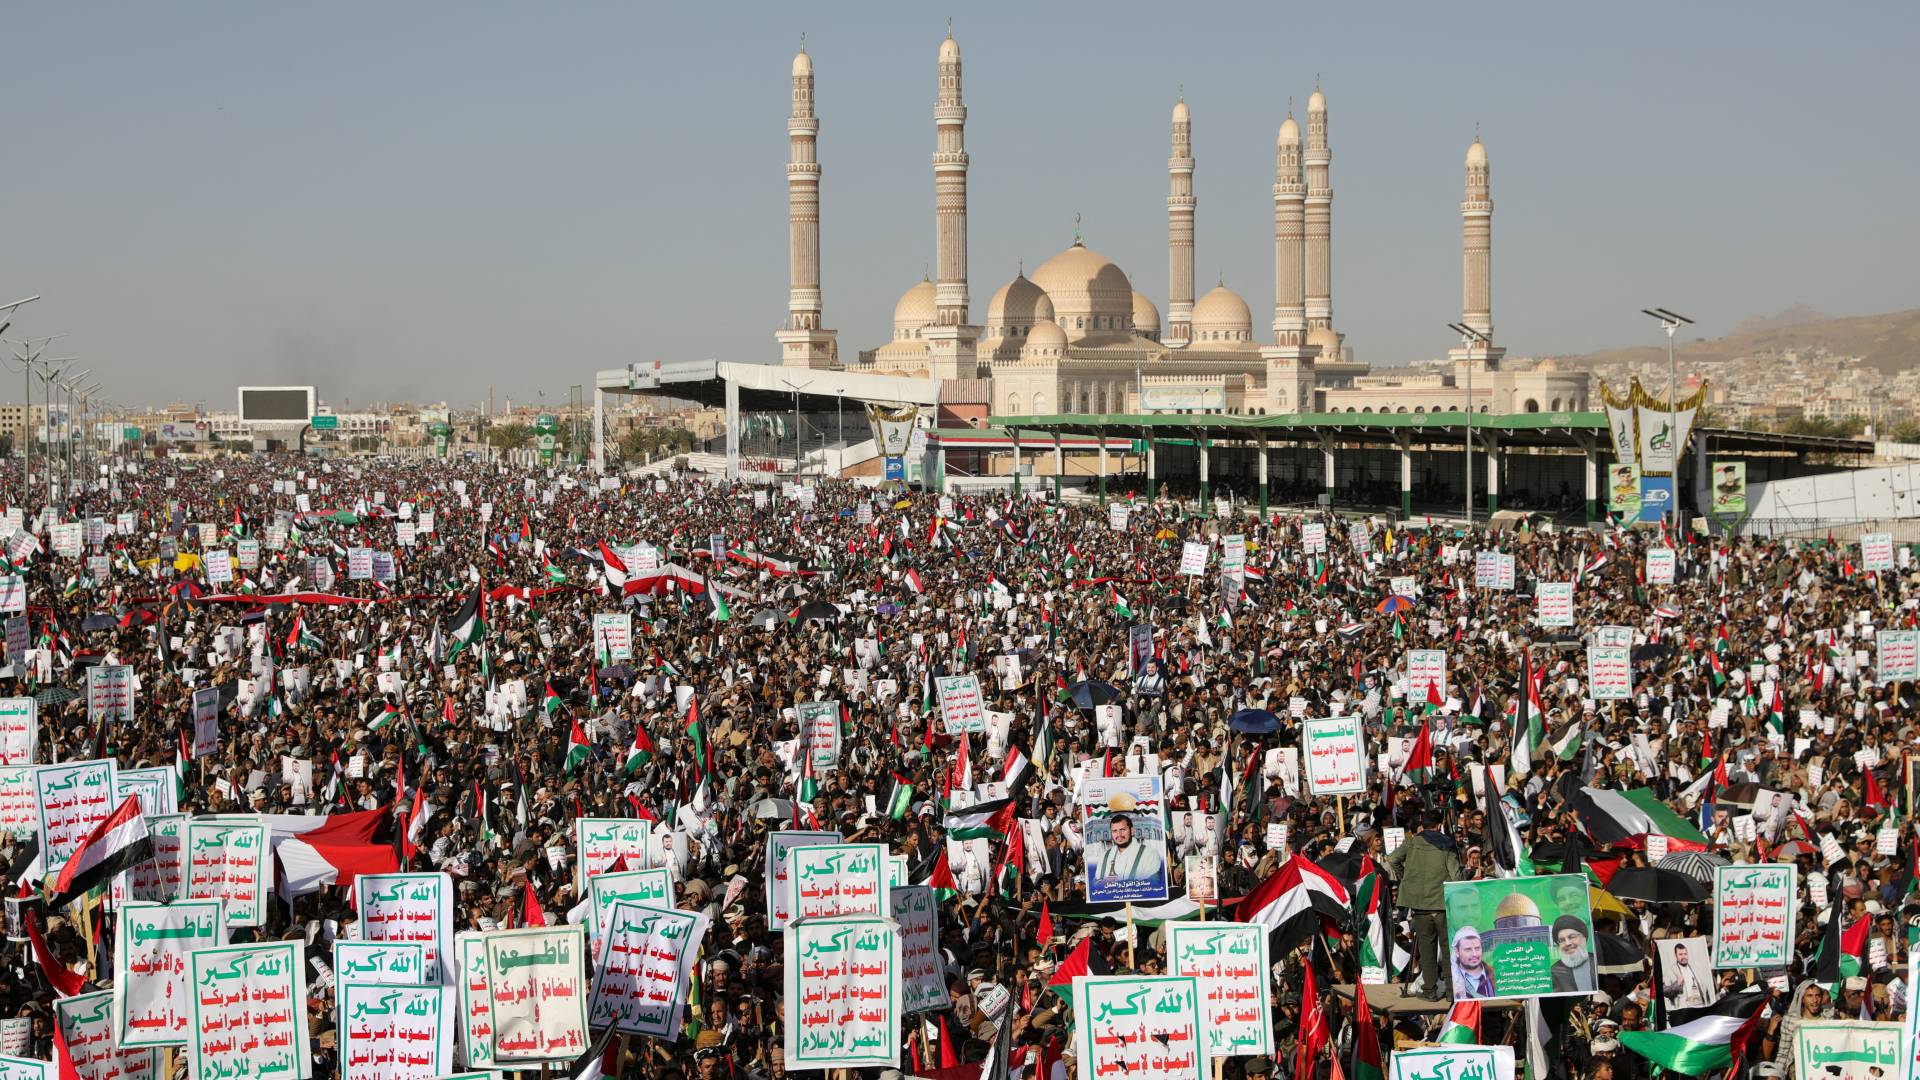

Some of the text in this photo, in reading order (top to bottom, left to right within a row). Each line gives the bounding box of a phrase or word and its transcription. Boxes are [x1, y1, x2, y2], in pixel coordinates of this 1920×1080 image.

[44, 769, 107, 796] الله أكبر
[81, 792, 109, 806] الموت
[194, 828, 259, 852] الله أكبر
[585, 825, 644, 845] الله أكبر
[229, 855, 256, 866] الموت
[800, 851, 845, 881] أكبر
[847, 854, 876, 874] الله
[229, 873, 256, 885] الموت
[800, 880, 876, 899] الموت لأمريكا
[1723, 870, 1787, 893] الله أكبر
[366, 879, 436, 907] الله أكبر
[597, 879, 664, 909] قاطعوا
[1757, 895, 1786, 907] الموت
[366, 906, 436, 924] الموت لأمريكا
[1756, 914, 1785, 925] الموت
[129, 914, 213, 946] قاطعوا
[615, 913, 690, 940] الله أكبر
[1721, 930, 1744, 943] اليهود
[650, 945, 681, 962] الموت
[801, 926, 888, 960] الله أكبر
[1179, 931, 1257, 962] الله أكبر
[256, 953, 290, 976] الله
[341, 949, 387, 979] أكبر
[389, 952, 417, 973] الله
[493, 939, 569, 975] قاطعوا
[200, 952, 253, 987] أكبر
[645, 967, 678, 983] الموت
[802, 957, 887, 980] الموت لأمريكا
[1224, 963, 1258, 980] الموت
[200, 985, 289, 1006] الموت لأمريكا
[542, 976, 577, 1001] البضائع
[600, 982, 629, 997] اليهود
[648, 989, 673, 1003] اللعنة
[802, 984, 887, 1005] الموت لإسرائيل
[1226, 986, 1258, 1001] الموت
[350, 989, 437, 1022] الله أكبر
[1093, 985, 1152, 1025] أكبر
[1155, 986, 1192, 1014] الله
[253, 1008, 291, 1027] الموت
[801, 1008, 887, 1028] اللعنة على اليهود
[1235, 1007, 1260, 1023] اللعنة
[264, 1032, 293, 1047] اللعنة
[350, 1024, 434, 1042] الموت لأمريكا
[801, 1027, 887, 1055] النصر للإسلام
[1227, 1027, 1262, 1051] النصر
[203, 1036, 236, 1057] اليهود
[1807, 1039, 1895, 1069] قاطعوا
[255, 1051, 294, 1080] النصر
[349, 1048, 434, 1068] الموت لإسرائيل
[1152, 1052, 1195, 1073] الموت
